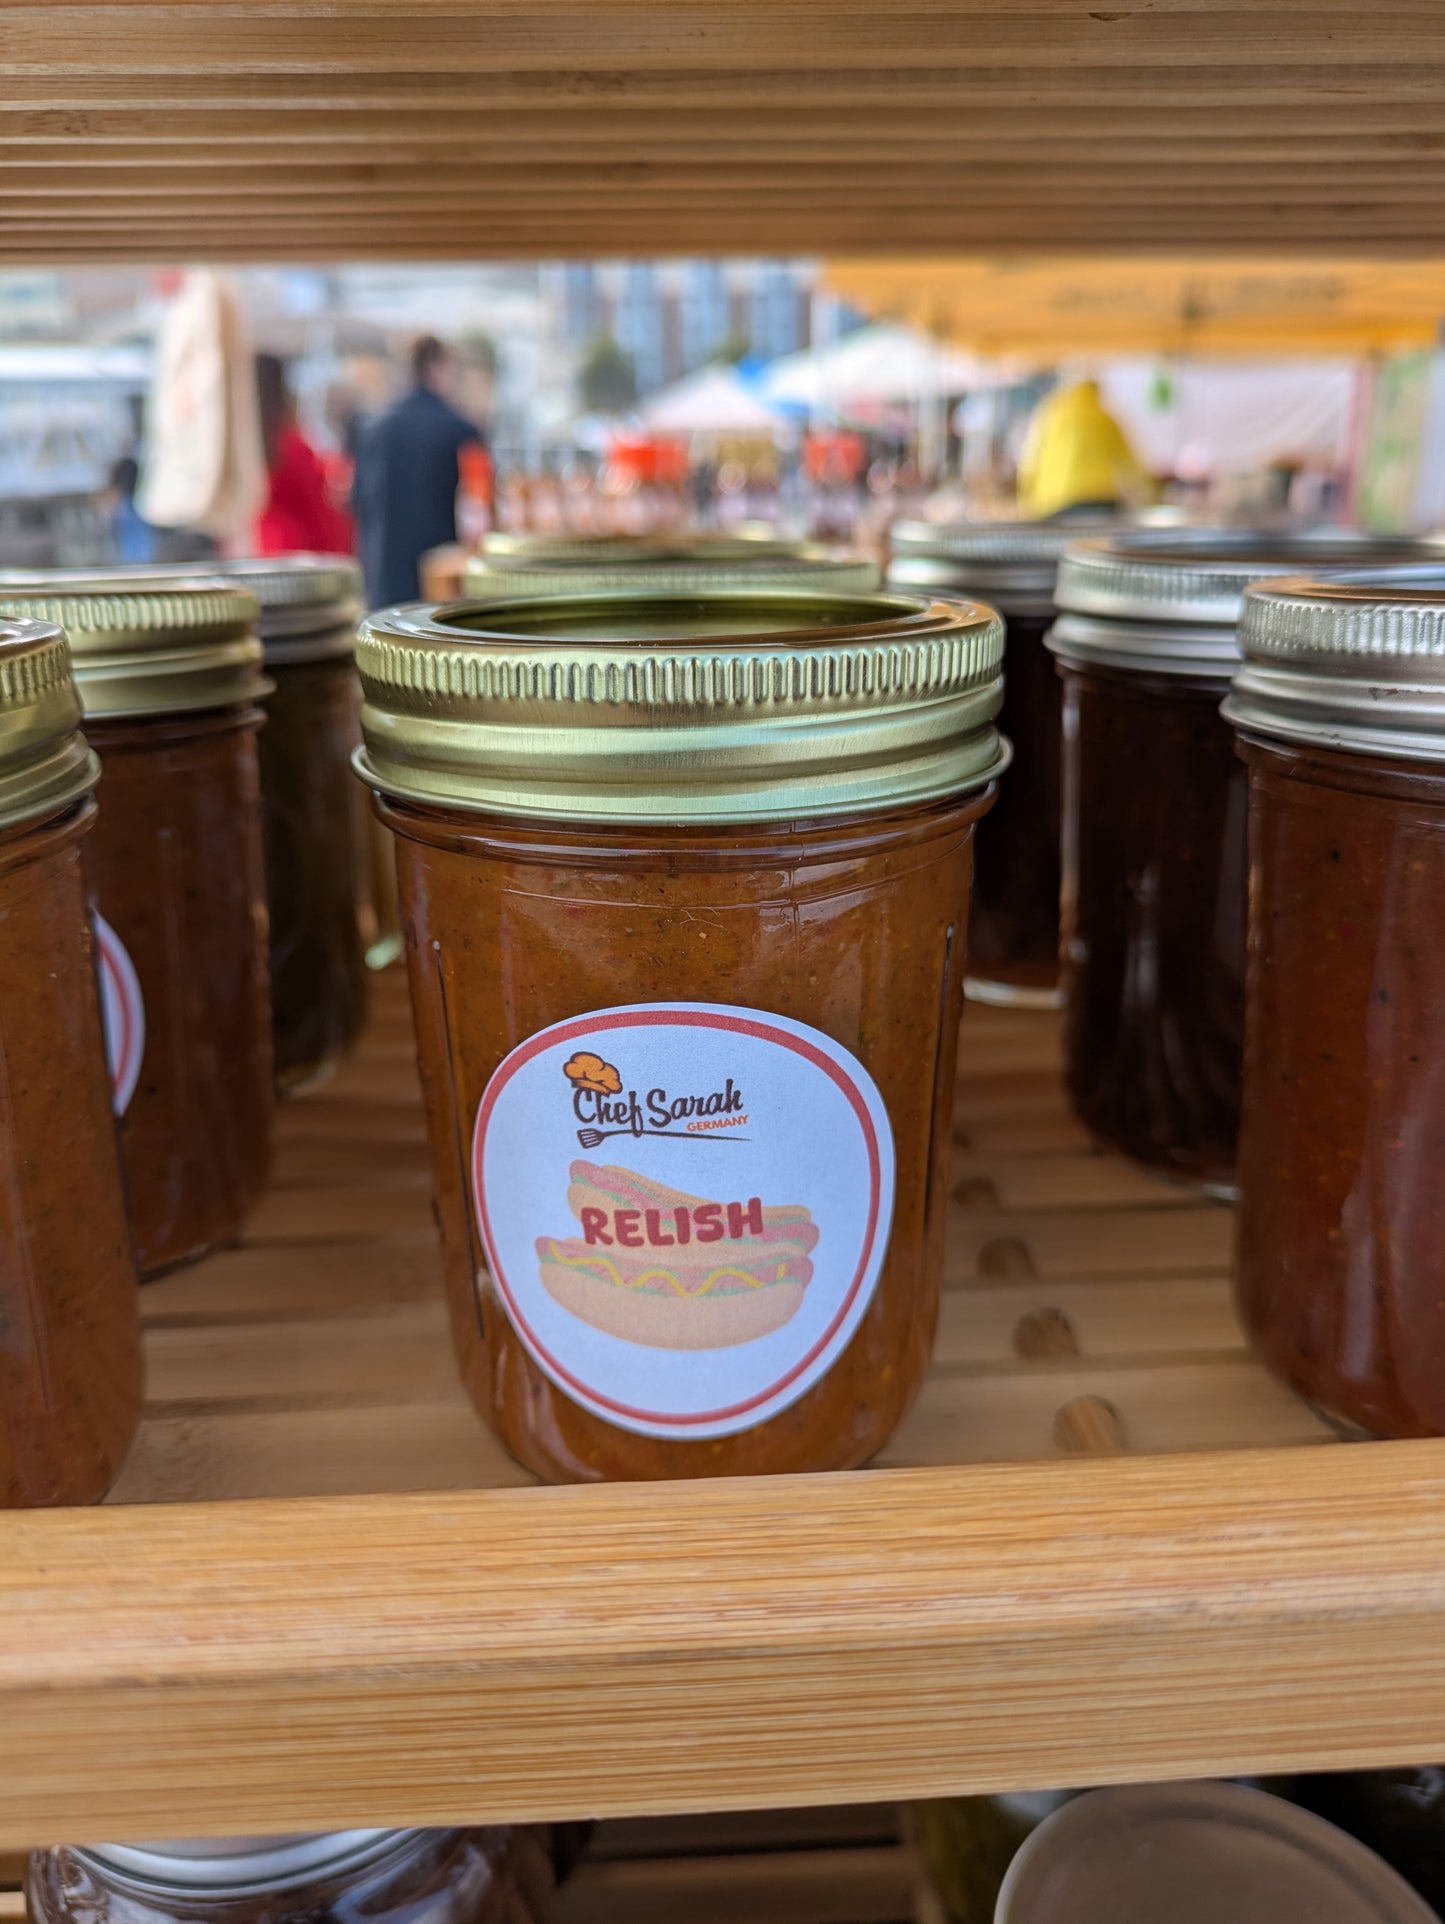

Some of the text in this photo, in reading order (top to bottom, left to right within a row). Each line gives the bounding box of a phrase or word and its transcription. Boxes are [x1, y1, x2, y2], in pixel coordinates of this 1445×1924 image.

[573, 1078, 744, 1138] Chef Sarah
[686, 1114, 749, 1132] GERMANY
[581, 1197, 763, 1247] RELISH
